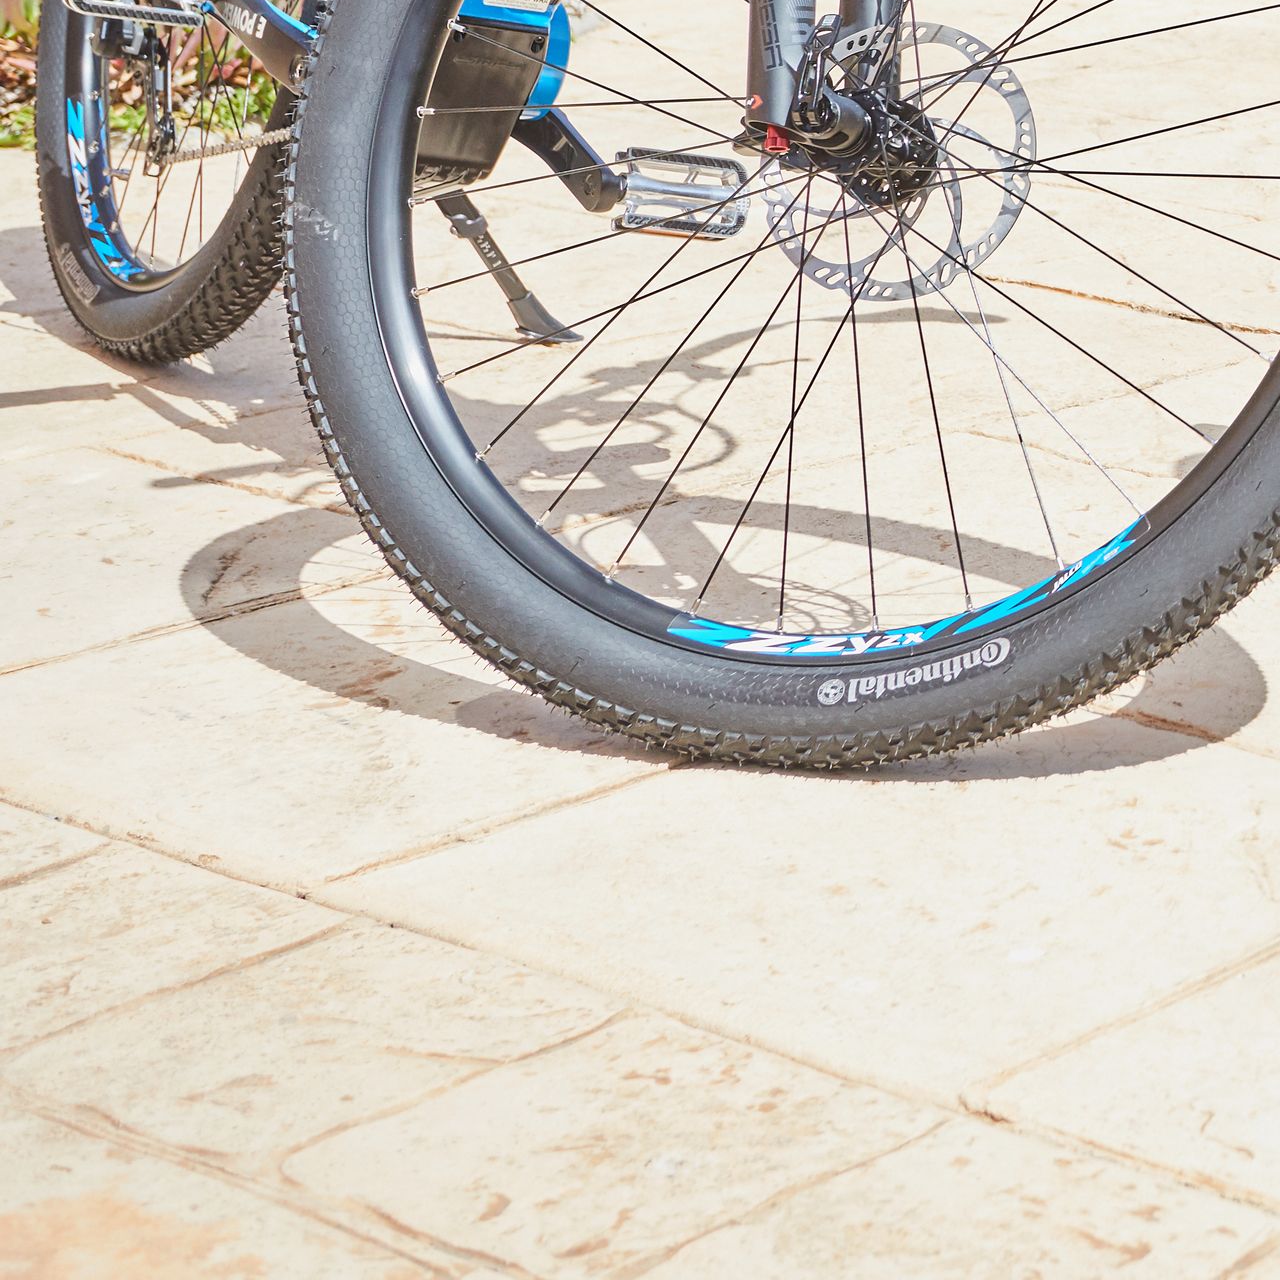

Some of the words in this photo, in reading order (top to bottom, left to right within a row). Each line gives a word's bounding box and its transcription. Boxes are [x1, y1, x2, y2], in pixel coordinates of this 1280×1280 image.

[255, 15, 268, 40] E
[1051, 560, 1084, 594] JALCO
[848, 636, 1012, 705] Continental
